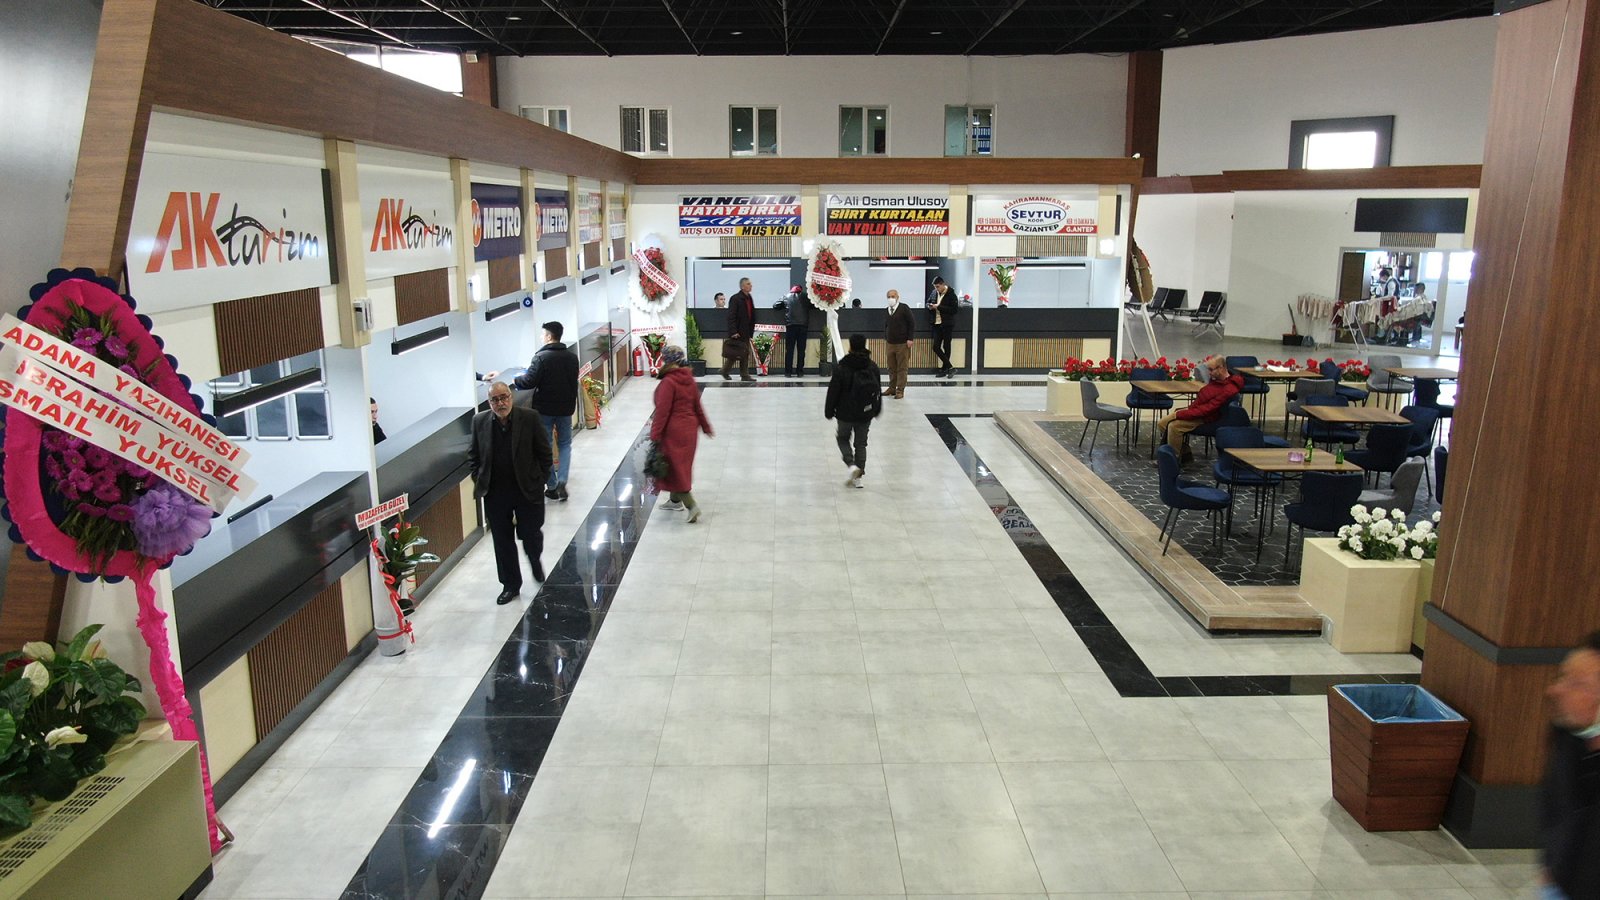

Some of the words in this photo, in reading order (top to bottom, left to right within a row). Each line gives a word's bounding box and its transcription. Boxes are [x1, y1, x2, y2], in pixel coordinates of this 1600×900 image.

[844, 196, 859, 206] Ali
[862, 196, 905, 206] Osman
[907, 196, 948, 208] Ulusoy
[680, 206, 737, 216] HATAY
[869, 209, 946, 221] KURTALAN
[1011, 209, 1062, 220] SEVTUR
[370, 198, 407, 252] AK
[483, 206, 522, 240] METRO
[542, 207, 569, 234] METRO
[145, 191, 229, 274] AK
[680, 228, 702, 236] MUŞ
[705, 227, 734, 235] OVASI
[742, 226, 768, 237] MUŞ
[770, 226, 799, 236] YOLU
[828, 222, 852, 235] VAN
[854, 222, 886, 235] YOLU
[1066, 225, 1094, 233] G.ANTEP
[3, 326, 97, 379] ADANA
[157, 432, 241, 492] YÜKSEL
